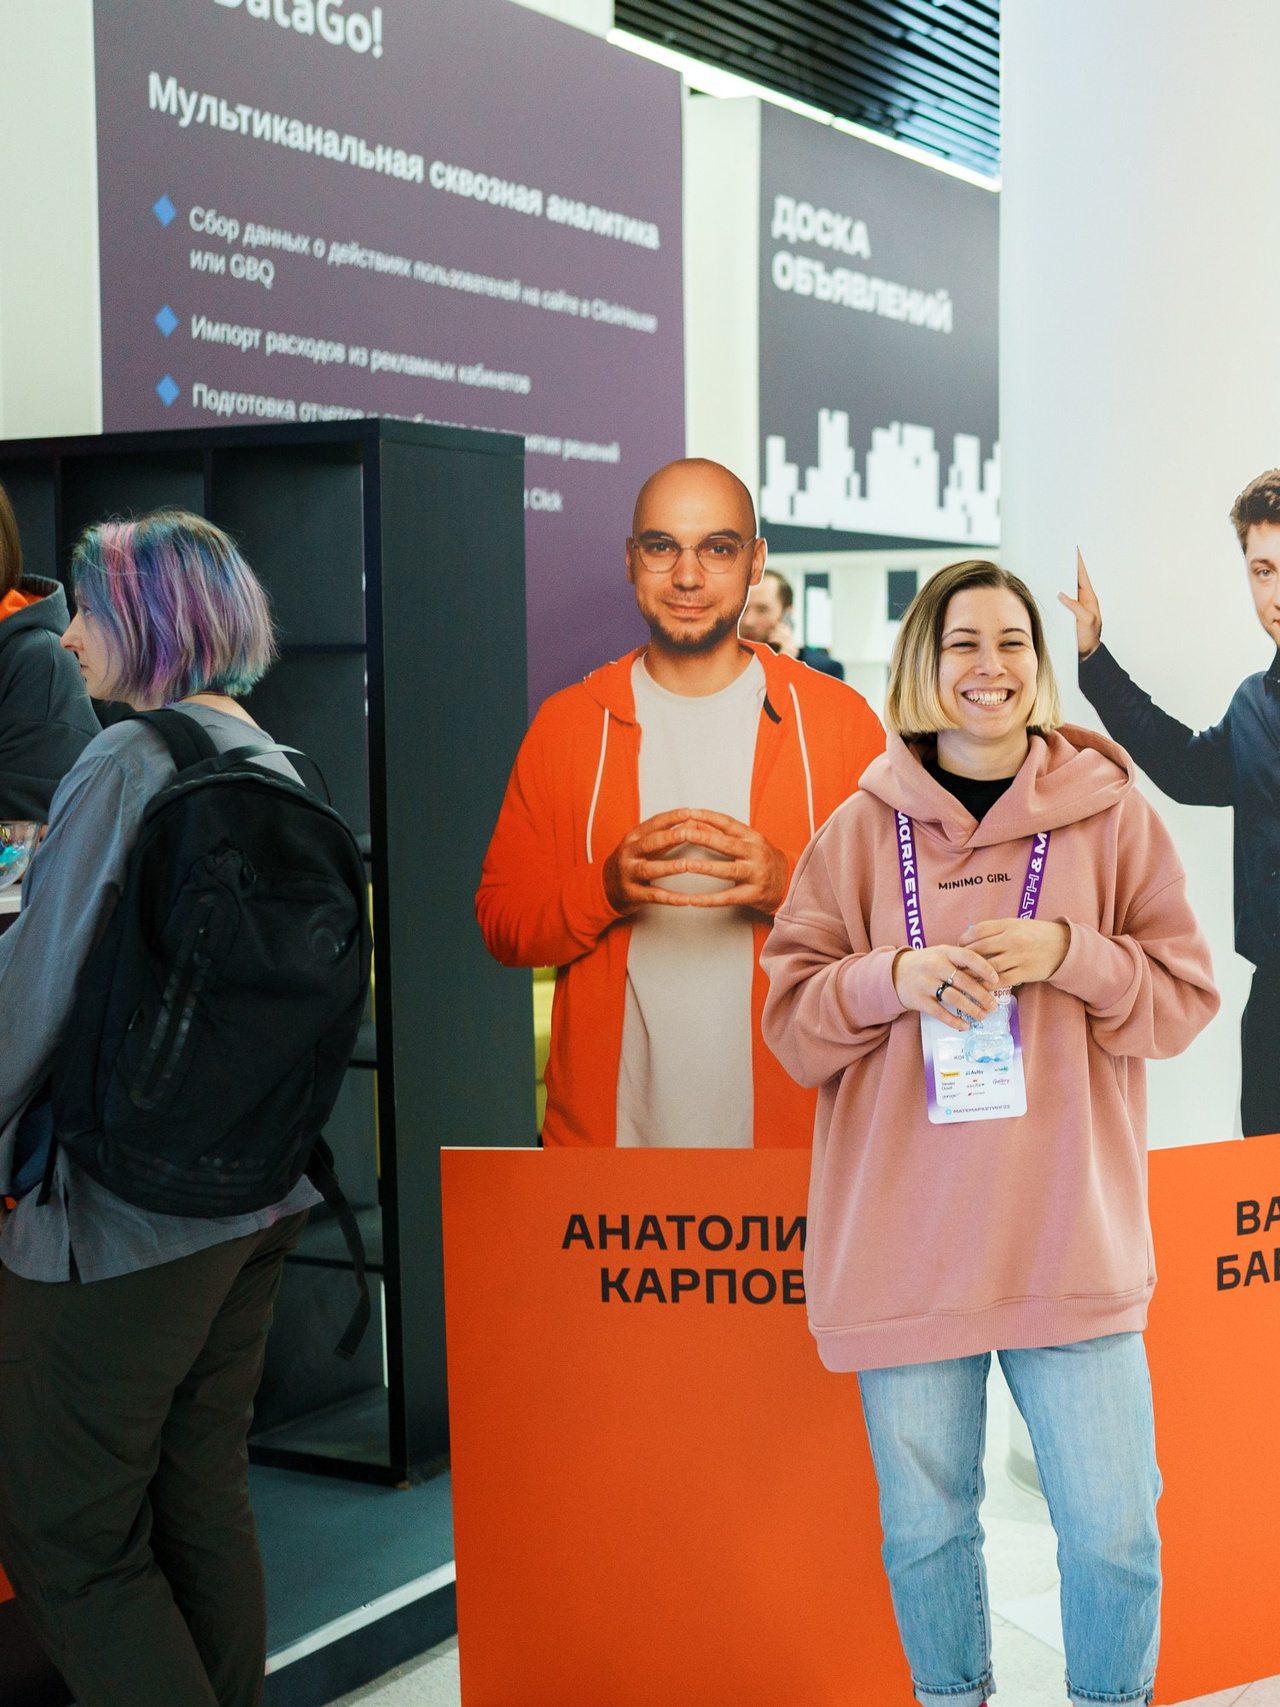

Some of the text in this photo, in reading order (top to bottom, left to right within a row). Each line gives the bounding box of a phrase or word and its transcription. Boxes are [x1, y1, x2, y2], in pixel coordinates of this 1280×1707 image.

[213, 0, 384, 59] ataGo!
[148, 71, 661, 251] Мультиканальная сквозная аналитика
[189, 205, 241, 244] Сбор
[241, 222, 311, 256] данных
[312, 237, 327, 259] о
[327, 240, 413, 279] действиях
[771, 194, 872, 260] ДОСКА
[189, 248, 276, 290] или GBQ
[772, 250, 954, 334] ОБЪЯВЛЕНИЙ
[191, 313, 532, 396] Импорт расходов из рекламных кабинетов
[192, 381, 297, 422] Подготовка
[938, 872, 1012, 891] MINIMO GIRL
[561, 1214, 807, 1252] АНАТОЛИ
[600, 1267, 806, 1305] КАРПОВ
